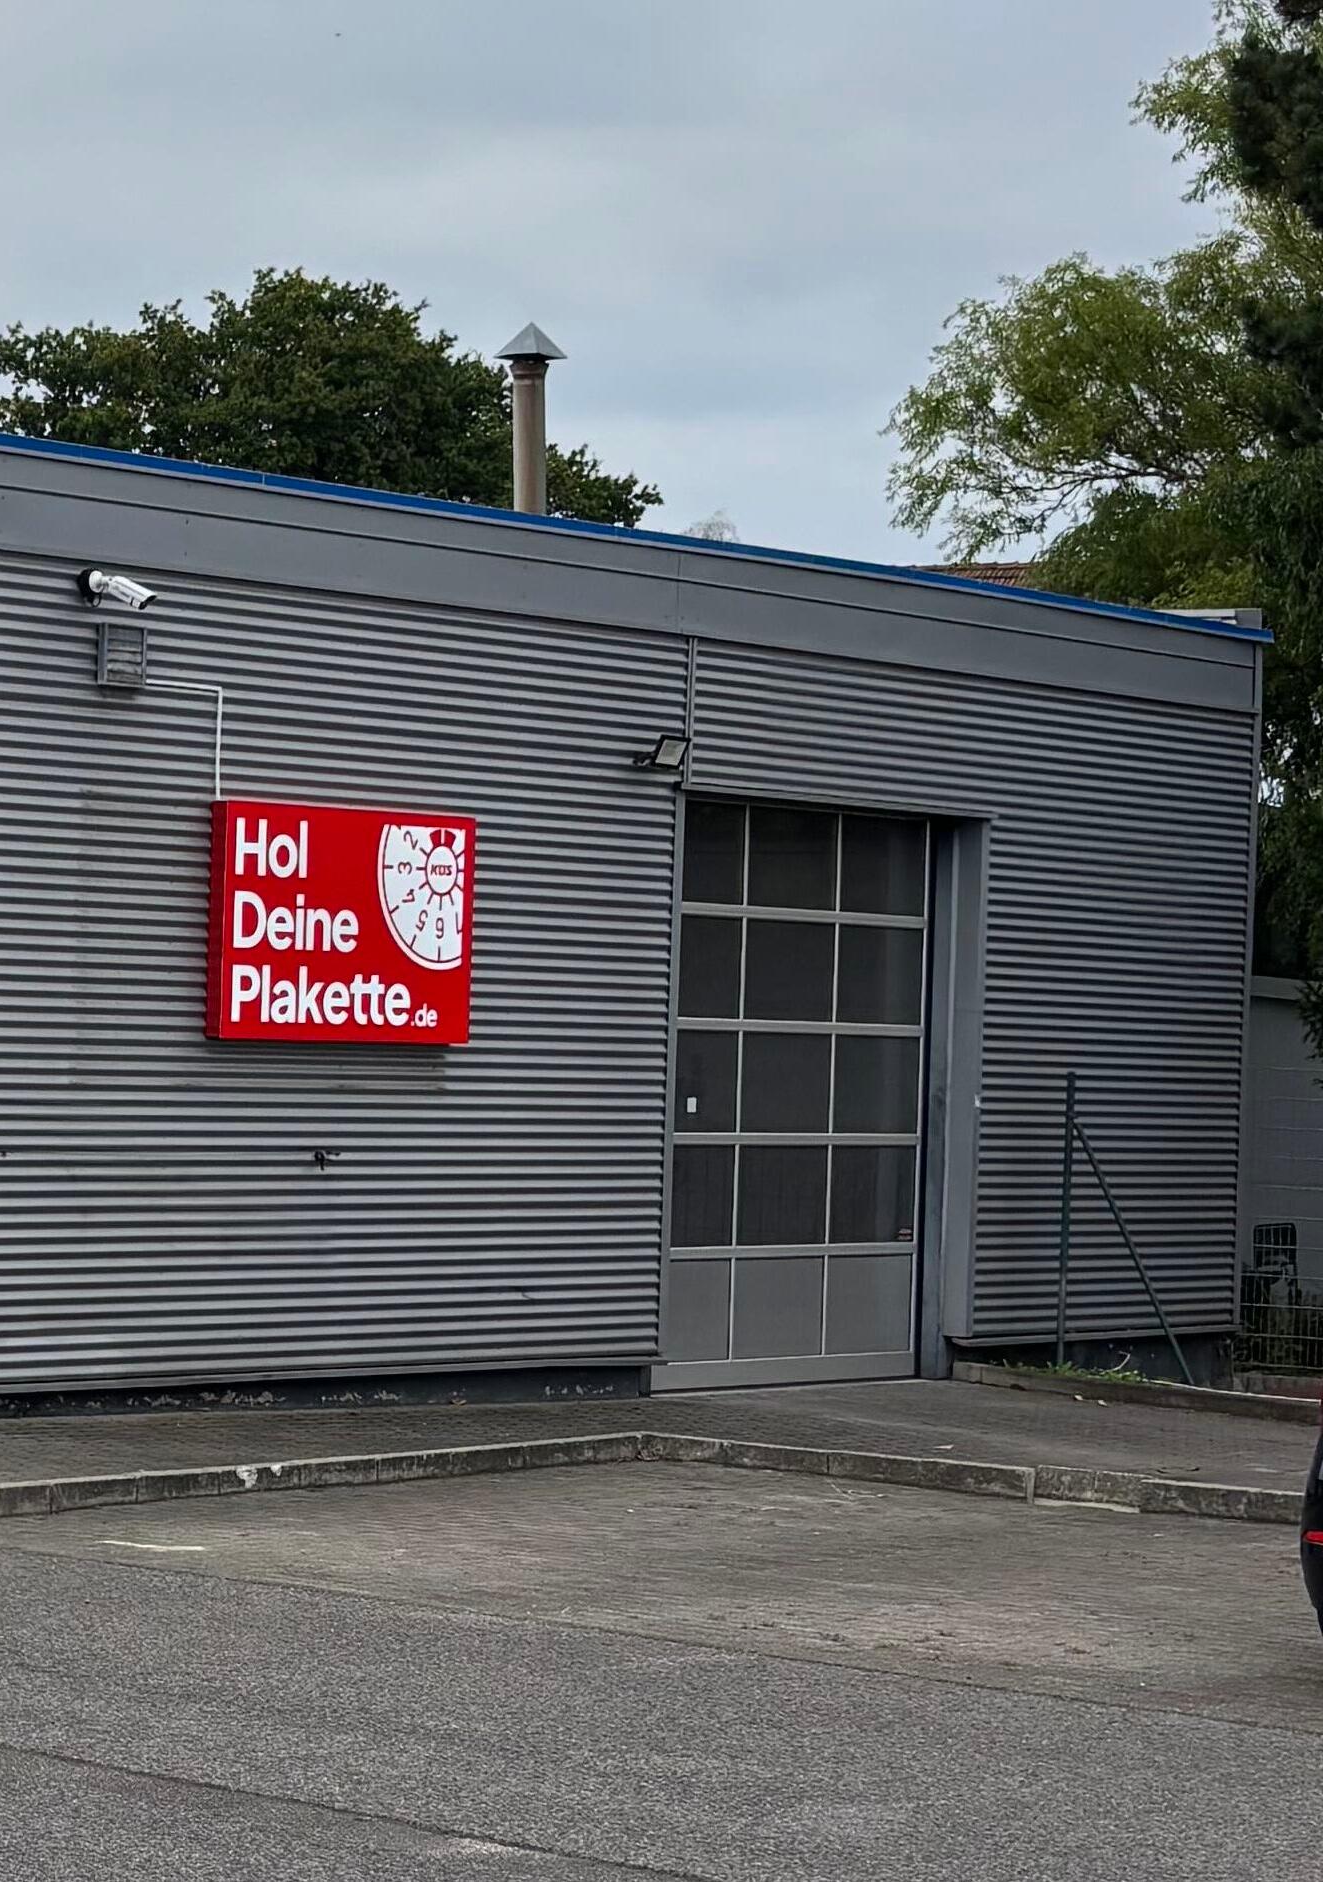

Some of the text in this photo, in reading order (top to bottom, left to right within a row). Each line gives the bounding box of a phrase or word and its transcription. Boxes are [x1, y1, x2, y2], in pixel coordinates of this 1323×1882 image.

[234, 816, 309, 879] Hol
[397, 861, 413, 875] 3
[232, 890, 359, 953] Deine
